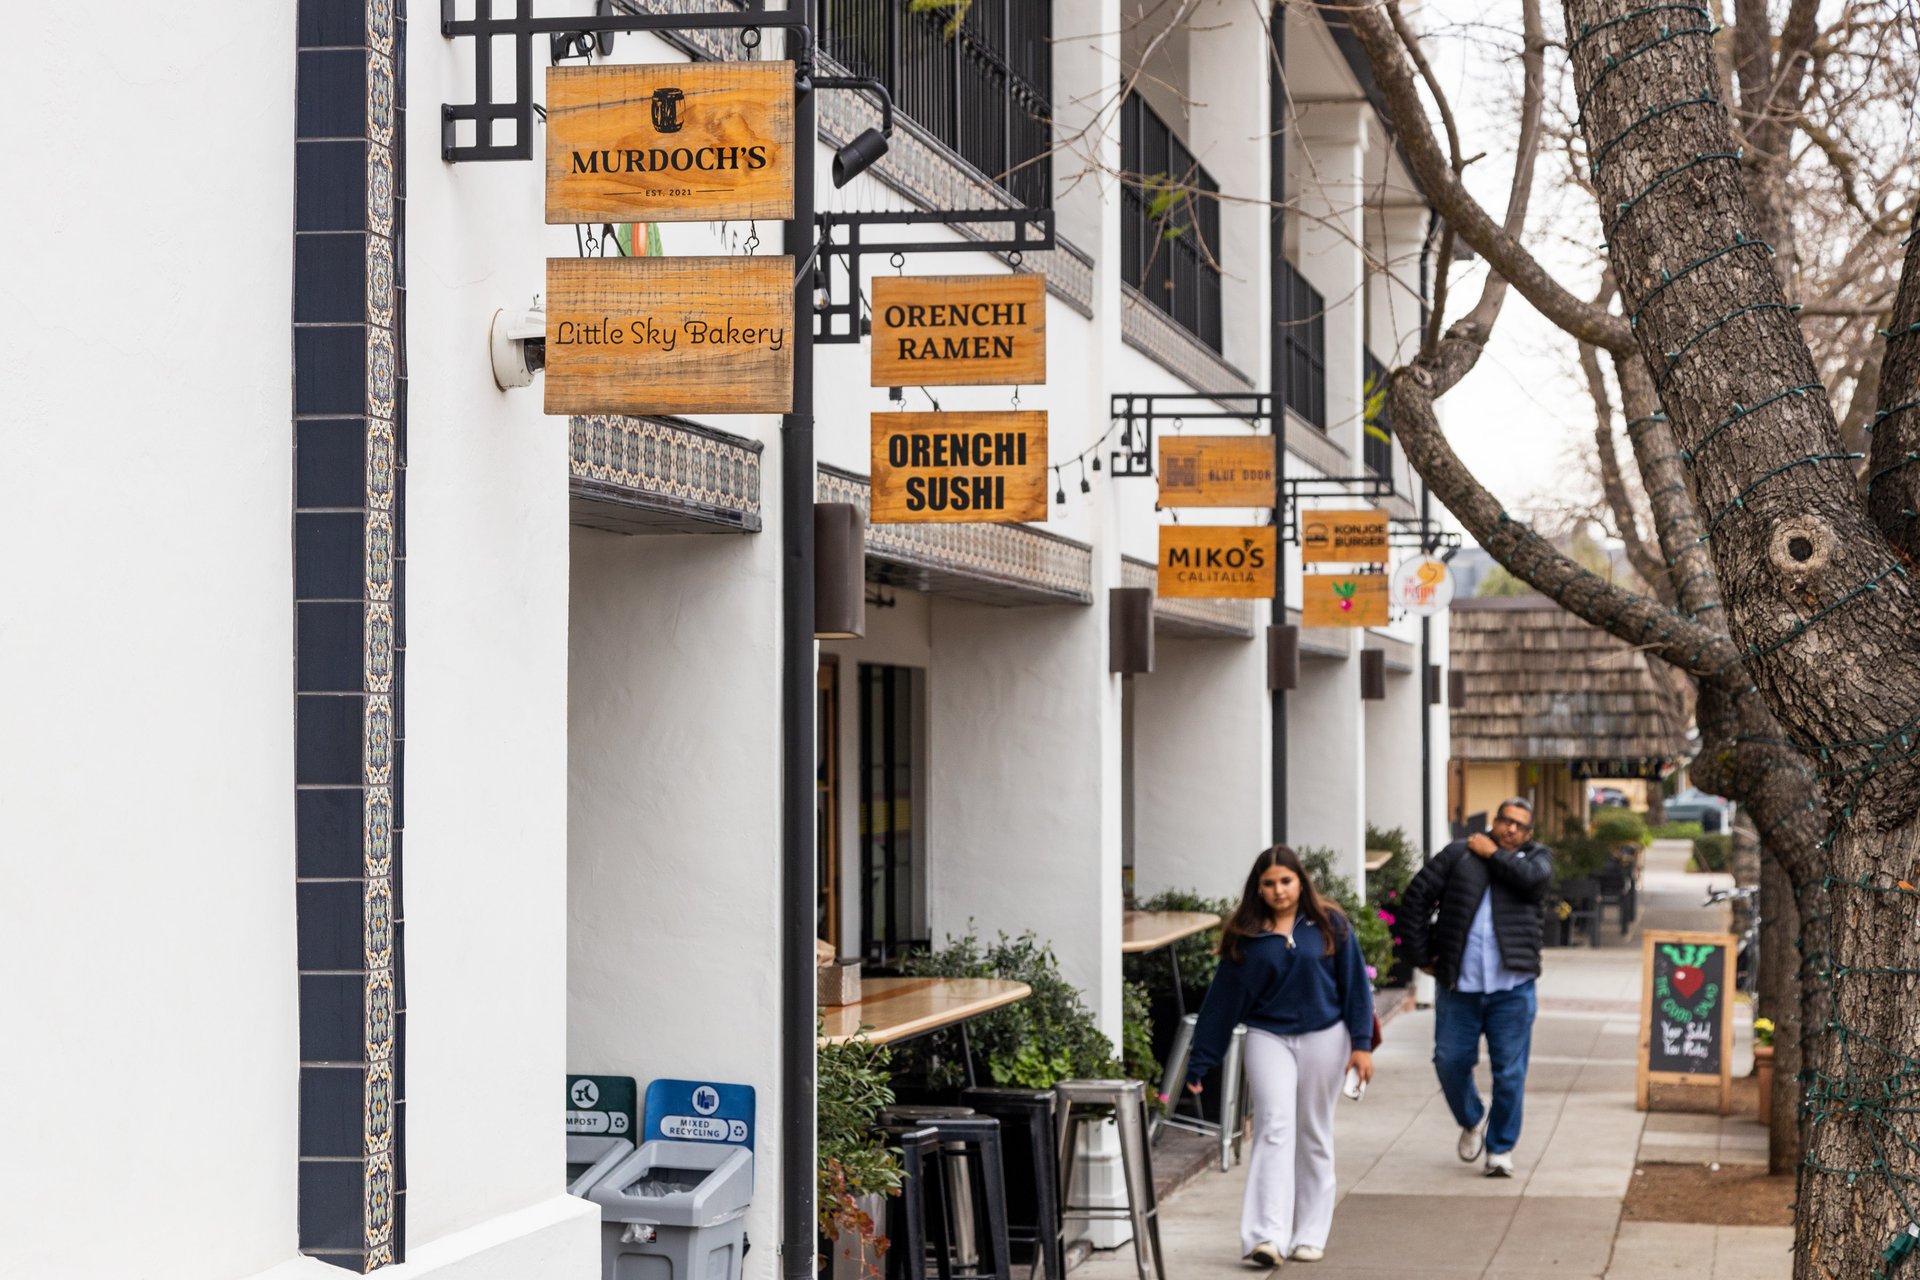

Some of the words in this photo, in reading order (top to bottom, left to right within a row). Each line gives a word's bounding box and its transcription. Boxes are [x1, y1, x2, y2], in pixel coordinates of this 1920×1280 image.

[572, 146, 767, 174] MURDOCH'S
[645, 189, 665, 197] EST.
[669, 188, 692, 196] 2021
[884, 303, 1027, 328] ORENCHI
[555, 317, 623, 345] Little
[631, 317, 676, 351] Sky
[684, 317, 783, 351] Bakery
[897, 336, 1014, 360] RAMEN
[889, 432, 1027, 467] ORENCHI
[1208, 469, 1234, 481] BLUE
[1242, 469, 1271, 481] DOOR
[906, 475, 1005, 511] SUSHI
[1168, 538, 1265, 569] MIKO'S
[1335, 536, 1386, 547] BURGER
[669, 1127, 720, 1138] RECYCLING
[680, 1119, 710, 1129] MIXED
